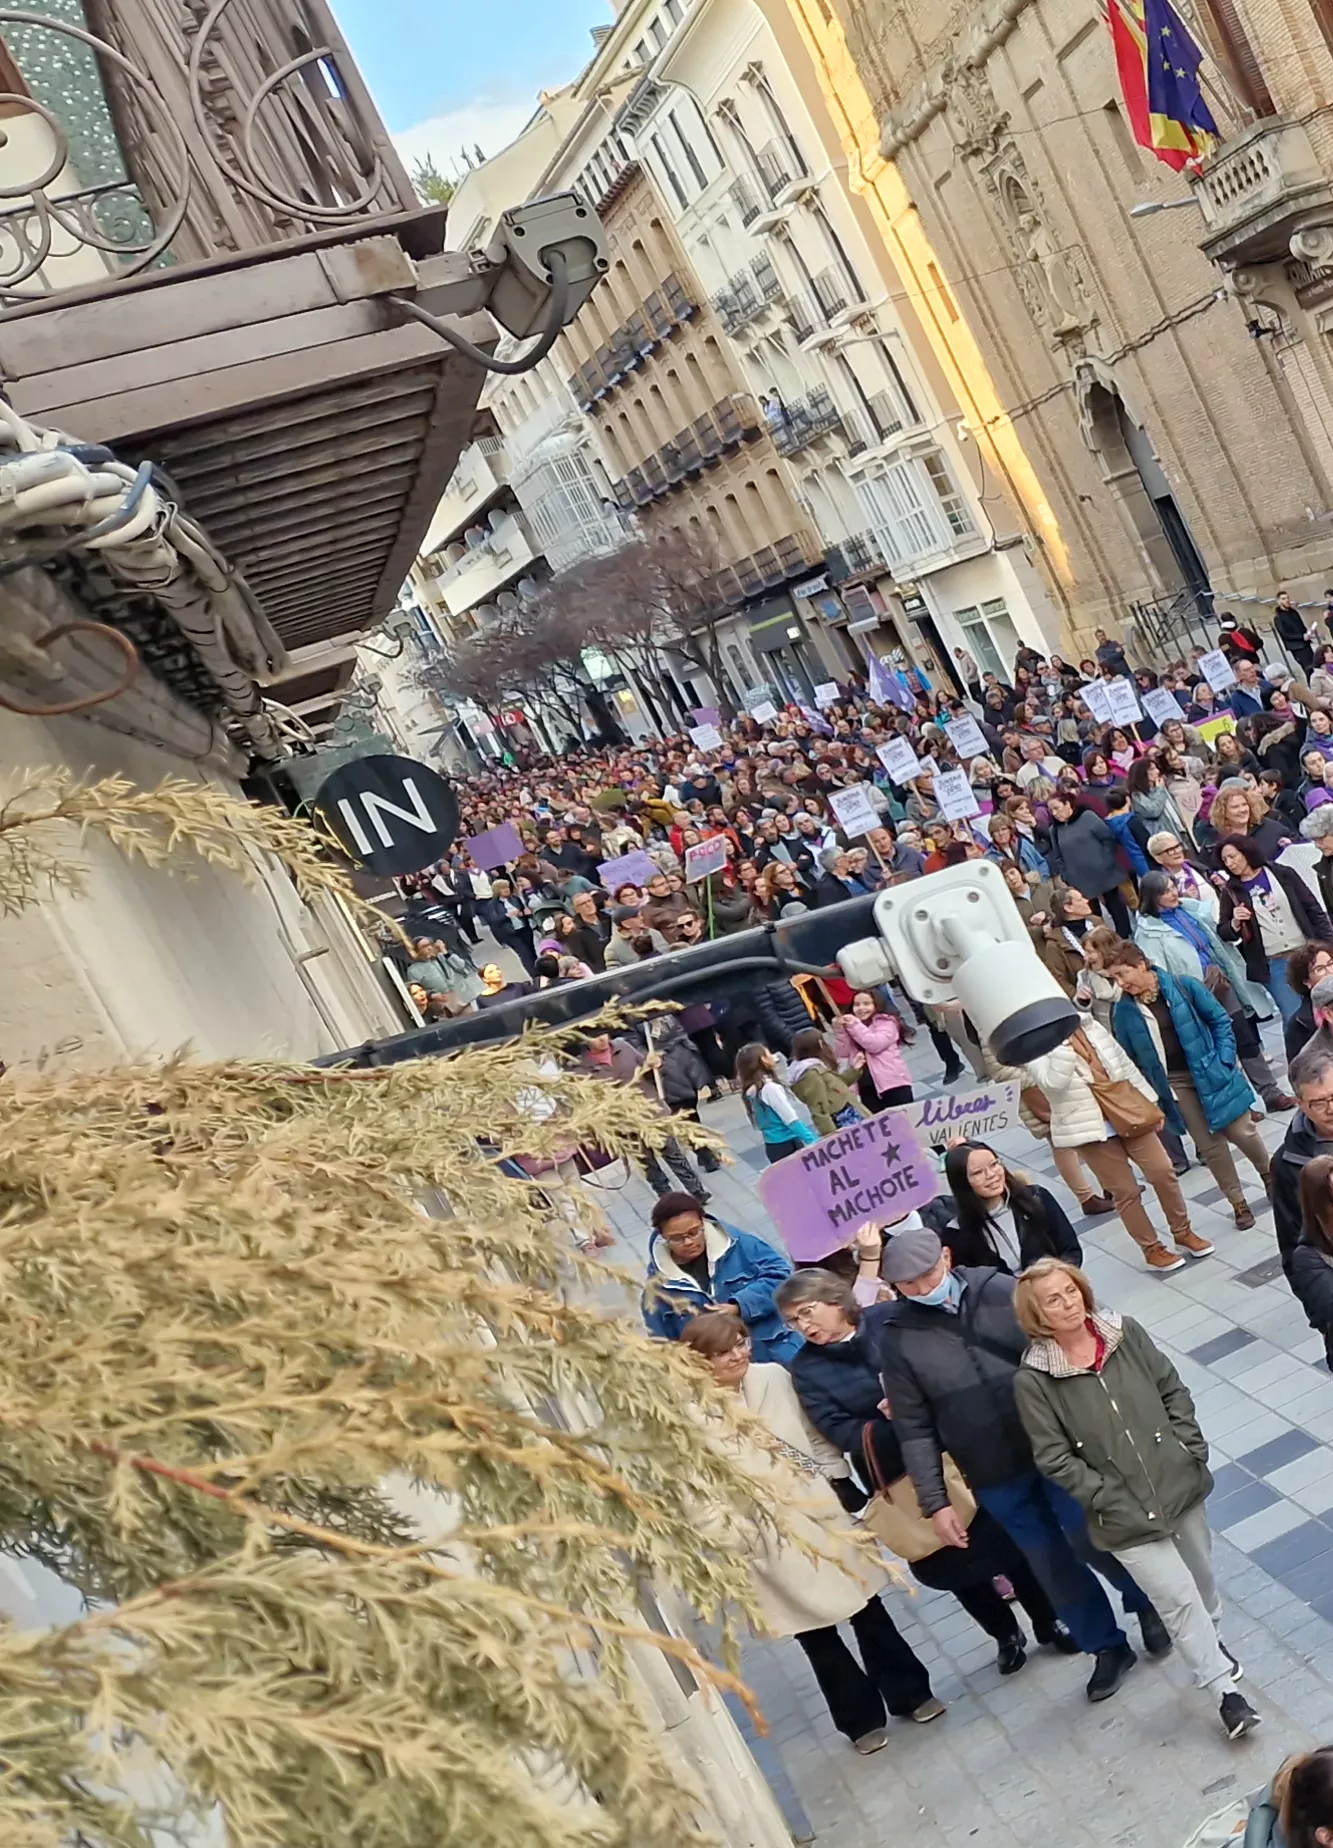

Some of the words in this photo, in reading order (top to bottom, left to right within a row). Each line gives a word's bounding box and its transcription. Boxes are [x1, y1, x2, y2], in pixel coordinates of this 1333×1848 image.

[337, 777, 437, 855] IN
[801, 1115, 892, 1172] MACHETE
[827, 1164, 919, 1228] MACHOTE
[829, 1165, 860, 1196] AL
